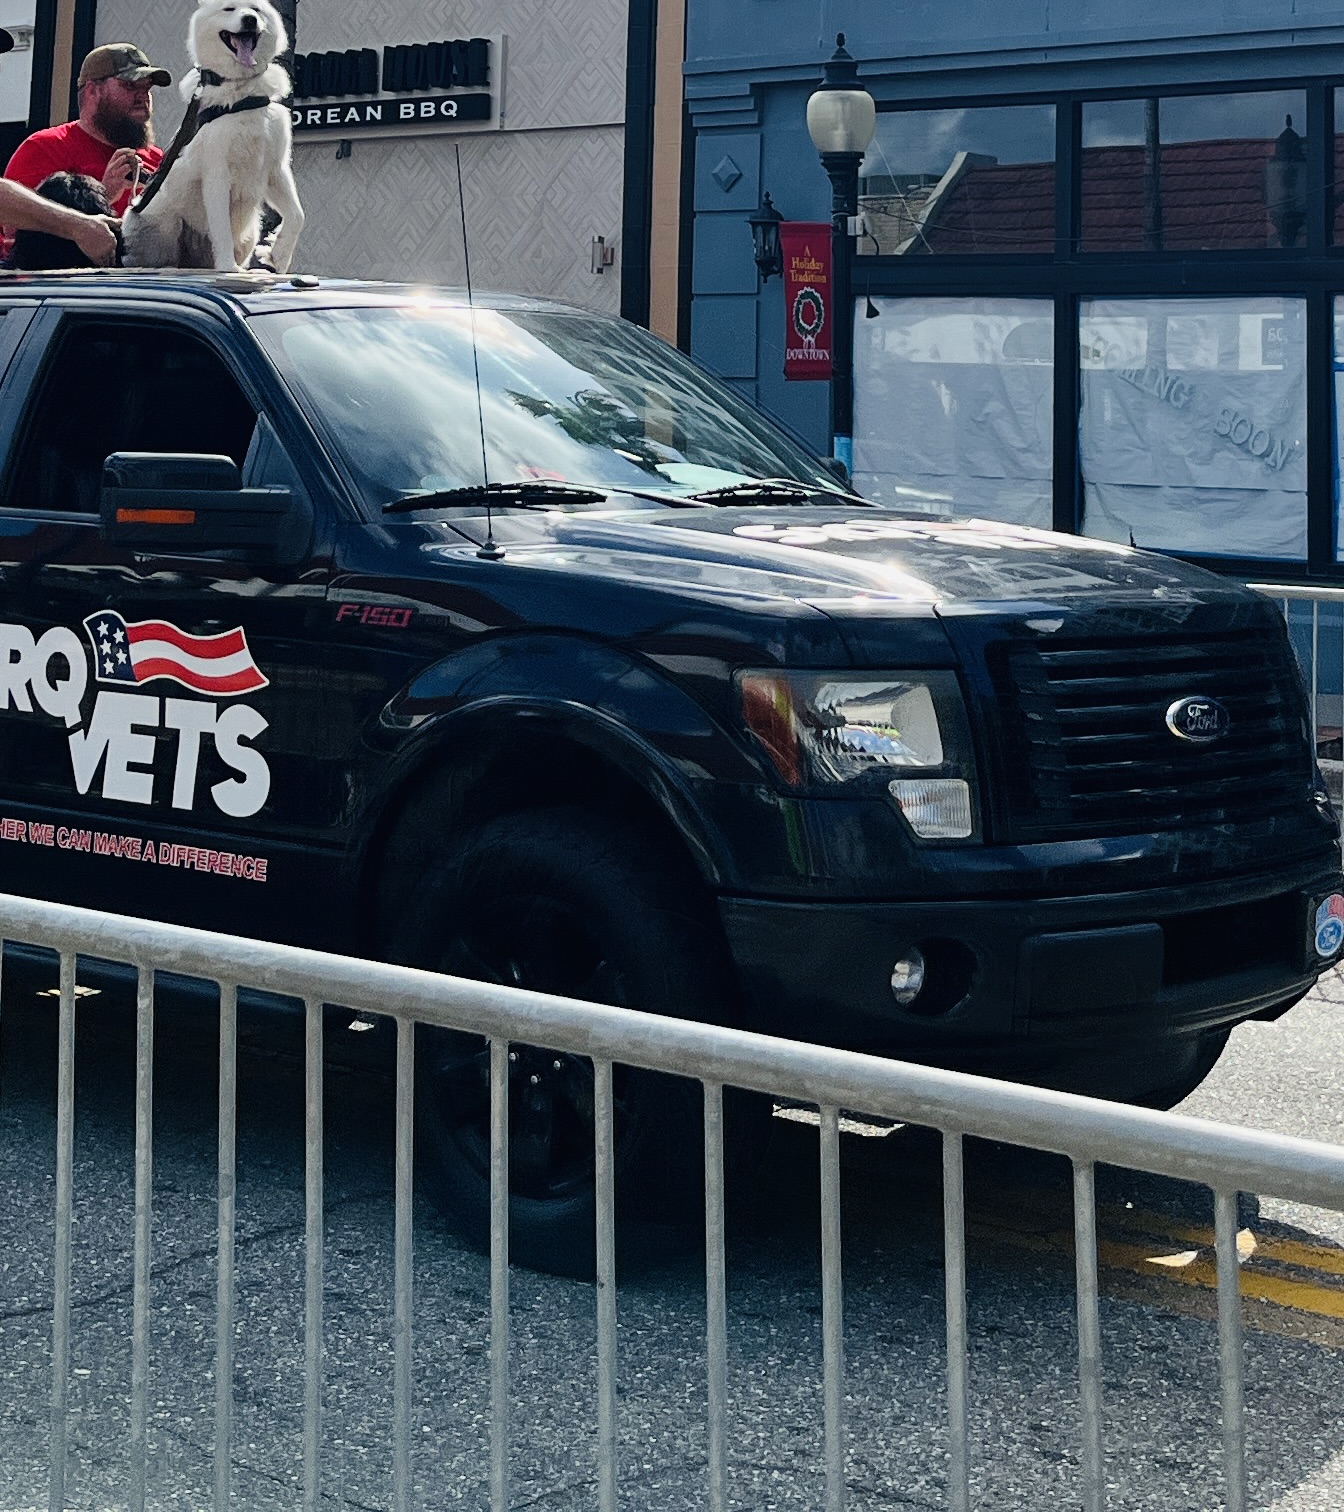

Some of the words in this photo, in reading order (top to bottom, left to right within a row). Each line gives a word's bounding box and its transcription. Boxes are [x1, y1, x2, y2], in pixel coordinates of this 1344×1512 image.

[292, 104, 383, 126] OREAN
[399, 99, 459, 120] BBQ
[803, 245, 811, 257] A
[791, 257, 825, 272] Holiday
[789, 270, 827, 284] Tradition
[786, 348, 830, 361] DOWNTOWN
[336, 604, 414, 628] F-150
[68, 691, 271, 818] VETS
[28, 821, 55, 846] WE
[56, 827, 91, 853] CAN
[93, 832, 142, 860] MAKE
[142, 840, 157, 863] A
[159, 842, 269, 882] DIFFERENCE
